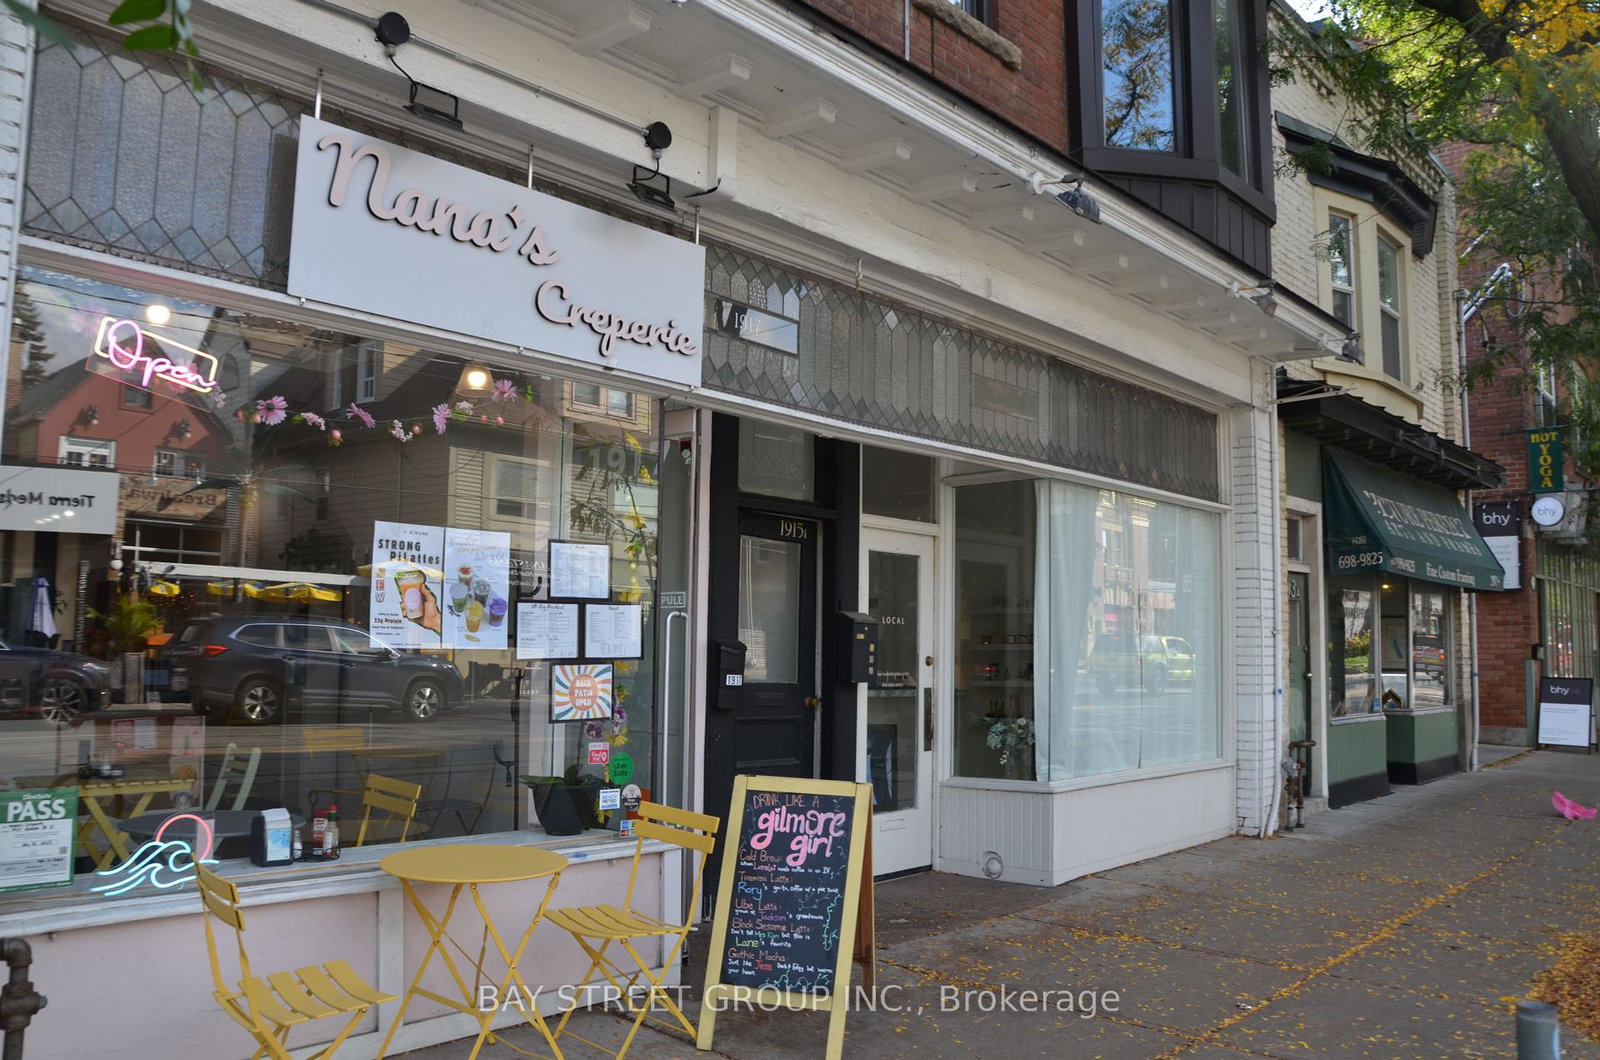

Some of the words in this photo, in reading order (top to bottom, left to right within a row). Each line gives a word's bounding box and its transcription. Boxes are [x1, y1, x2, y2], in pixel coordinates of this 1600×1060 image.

[318, 133, 560, 266] Nana's
[536, 280, 698, 357] Creperie
[734, 311, 760, 335] 1917
[107, 319, 216, 387] Open
[1530, 431, 1558, 443] HOT
[1538, 444, 1554, 488] YOGA
[1537, 506, 1557, 517] bhy
[1482, 512, 1511, 526] bhy
[378, 539, 421, 551] STRONG
[1338, 551, 1384, 569] 698-9825
[882, 616, 905, 625] LOCAL
[1550, 685, 1570, 696] bhy
[614, 769, 628, 777] Eats
[753, 794, 781, 809] DRINK
[785, 795, 806, 808] LIKE
[812, 796, 820, 808] A
[7, 798, 66, 822] PASS
[750, 806, 847, 850] gilmore
[740, 849, 756, 862] Cold
[786, 834, 833, 867] girl
[735, 898, 754, 910] Ube
[732, 917, 754, 929] Black
[755, 918, 787, 931] Sesame
[728, 947, 755, 959] Gothic
[754, 960, 773, 971] Jess
